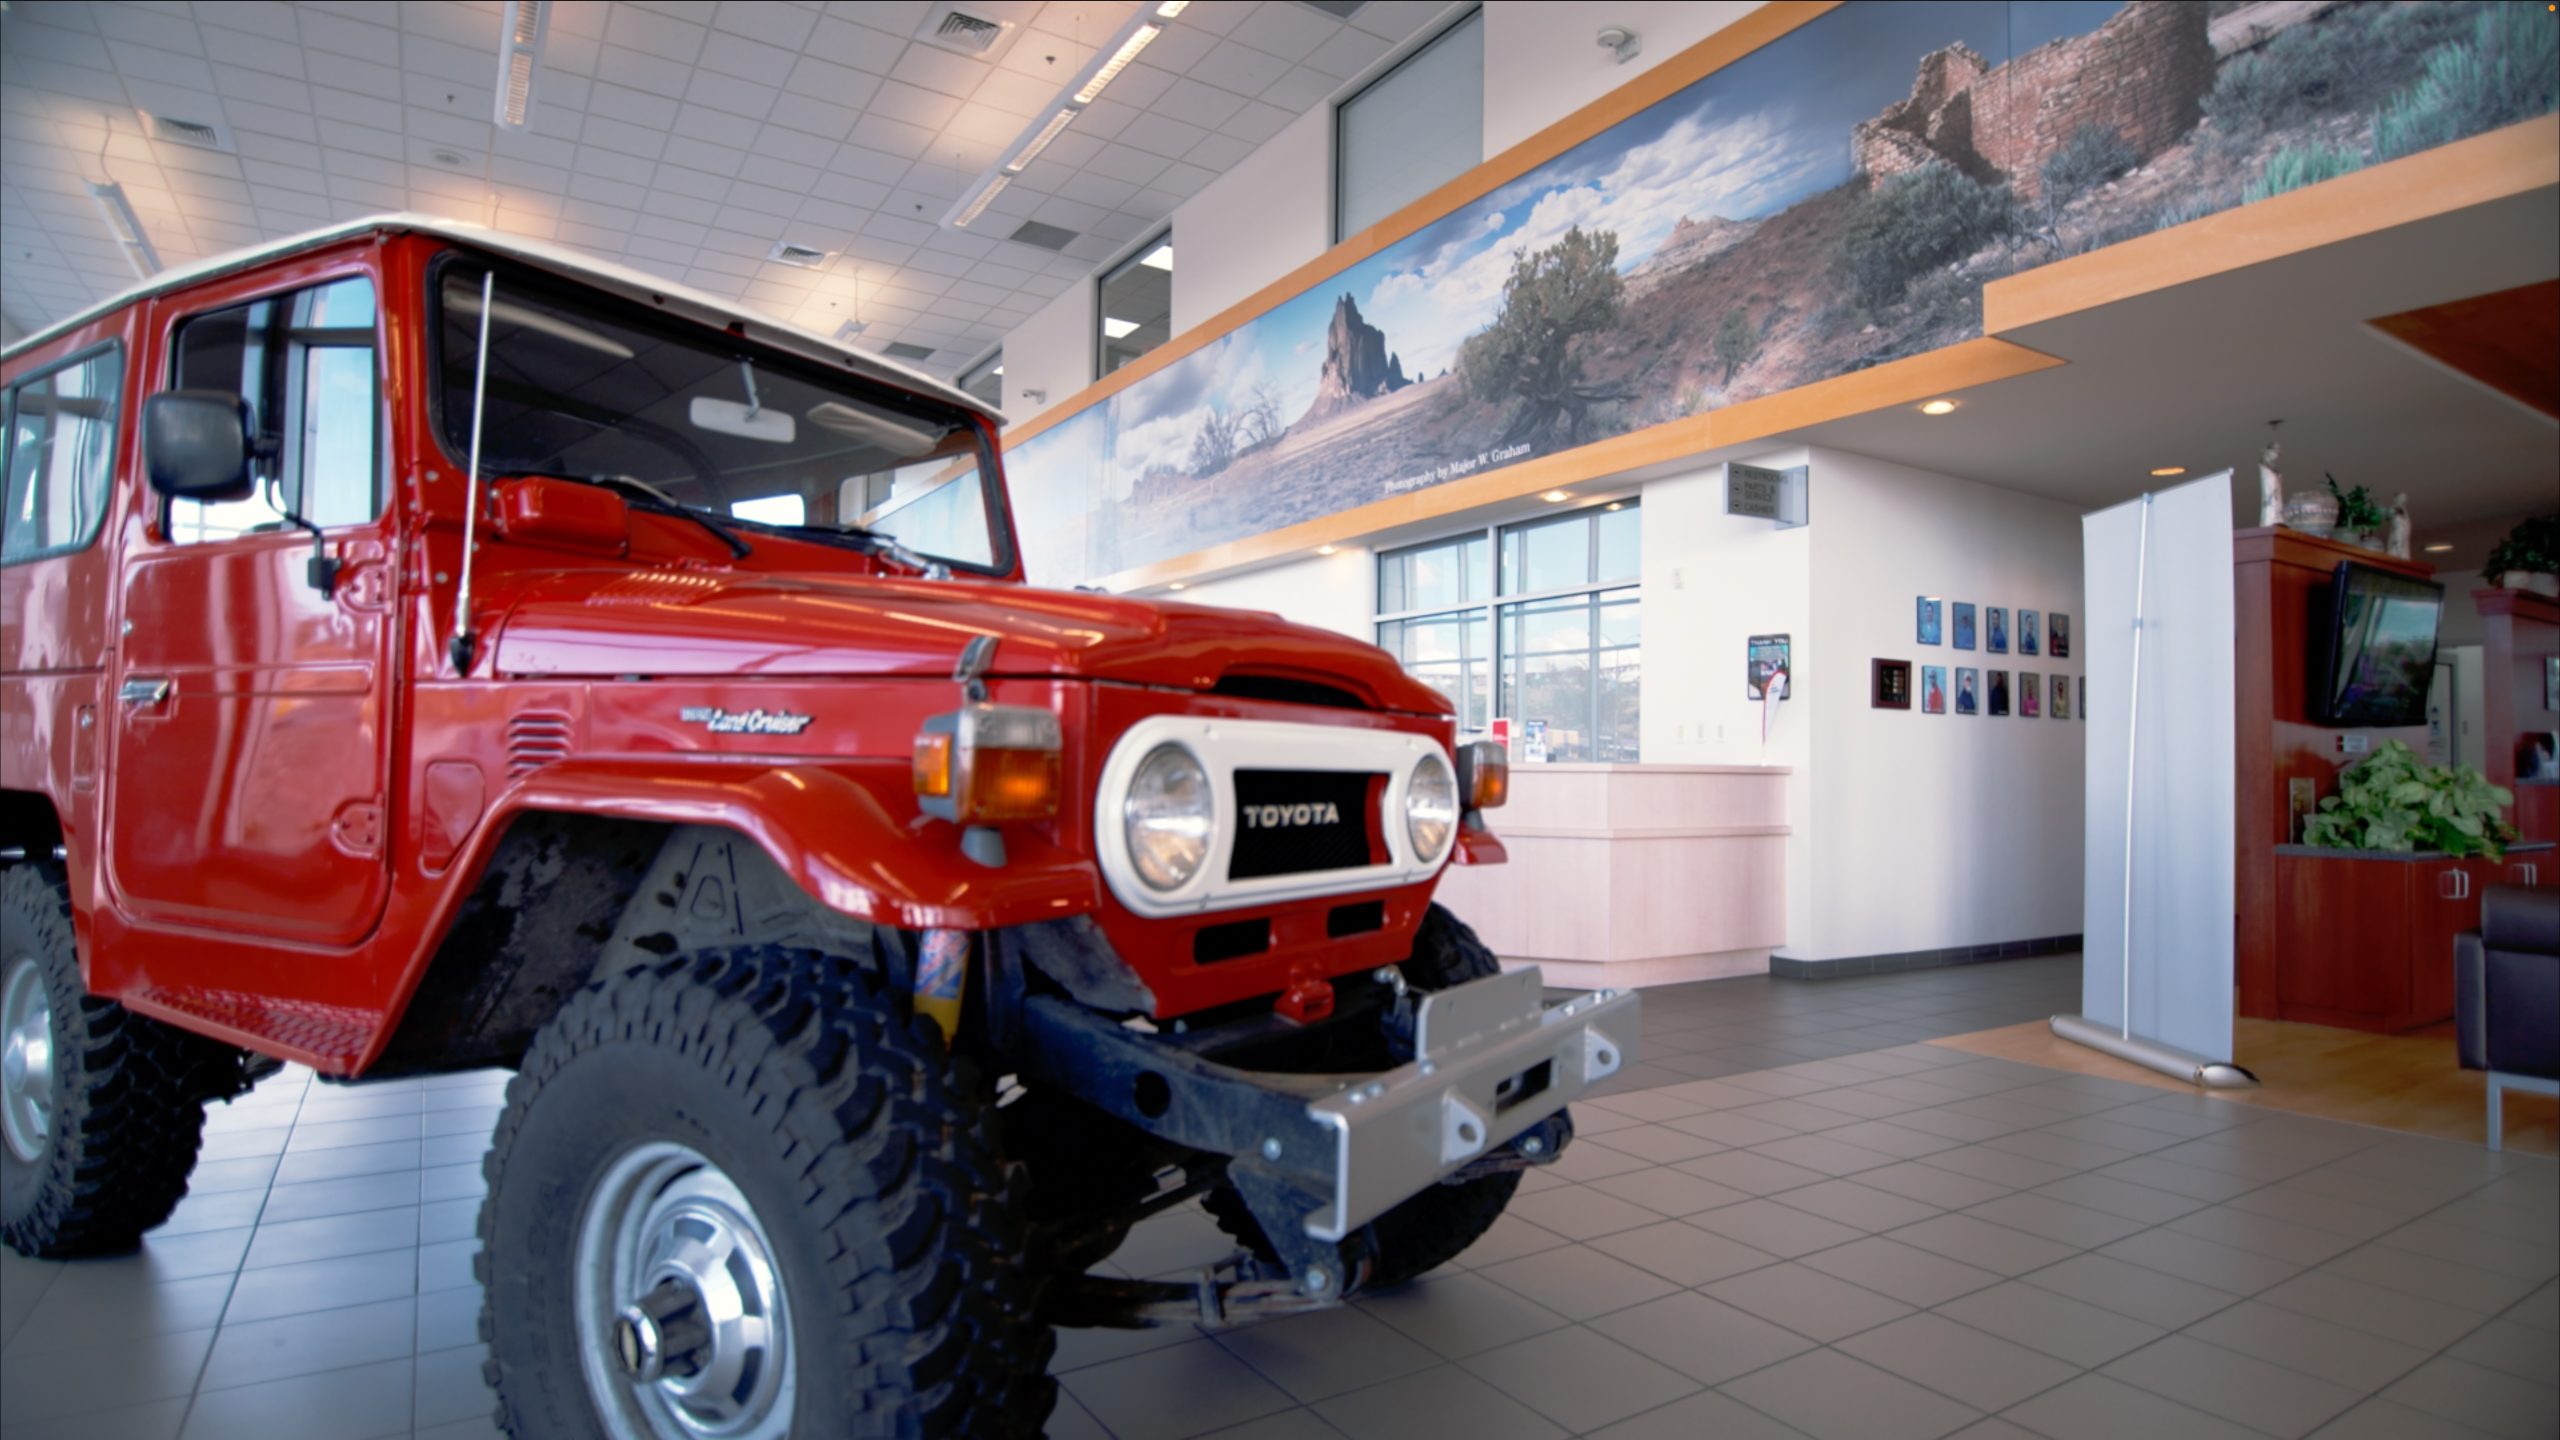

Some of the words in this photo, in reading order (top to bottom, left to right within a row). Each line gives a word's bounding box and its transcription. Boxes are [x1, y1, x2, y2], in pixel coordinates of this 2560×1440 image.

[1384, 470, 1435, 493] Photography
[1437, 467, 1449, 480] by
[1450, 458, 1477, 474] Major
[1478, 452, 1489, 465] W.
[1491, 443, 1531, 462] Graham
[1744, 481, 1766, 493] PARTS
[1744, 502, 1775, 514] CASHIER
[707, 708, 750, 731] Land
[748, 708, 811, 733] Cruiser
[1243, 802, 1340, 828] TOYOTA
